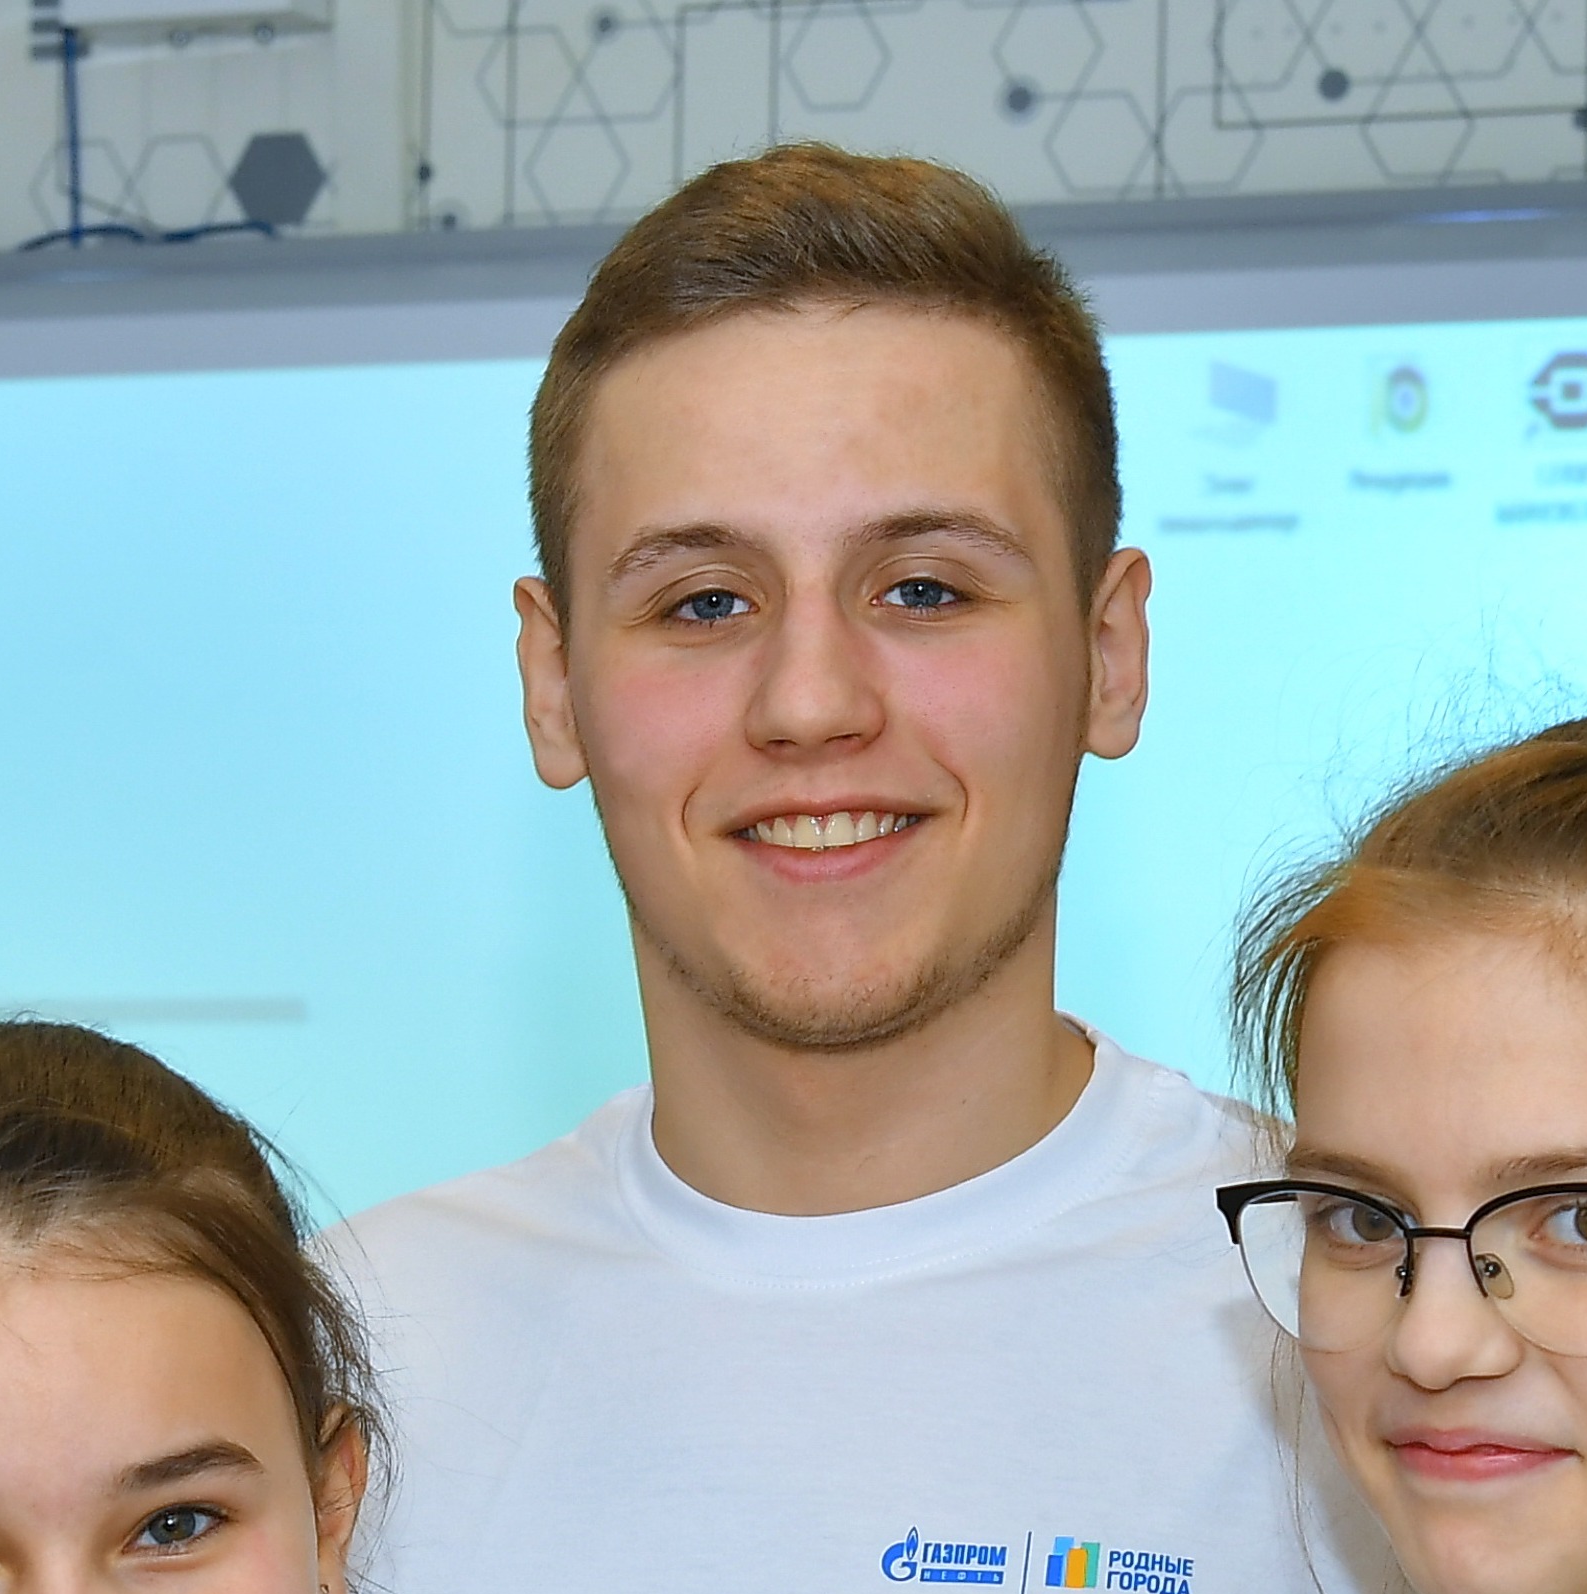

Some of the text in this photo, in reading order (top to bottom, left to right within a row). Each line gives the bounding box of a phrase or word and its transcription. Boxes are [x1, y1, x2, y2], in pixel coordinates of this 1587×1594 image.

[921, 1542, 1007, 1567] ГАЗПРОМ
[1108, 1550, 1194, 1577] РОДНЫЕ
[922, 1570, 1002, 1583] НЕФТЬ
